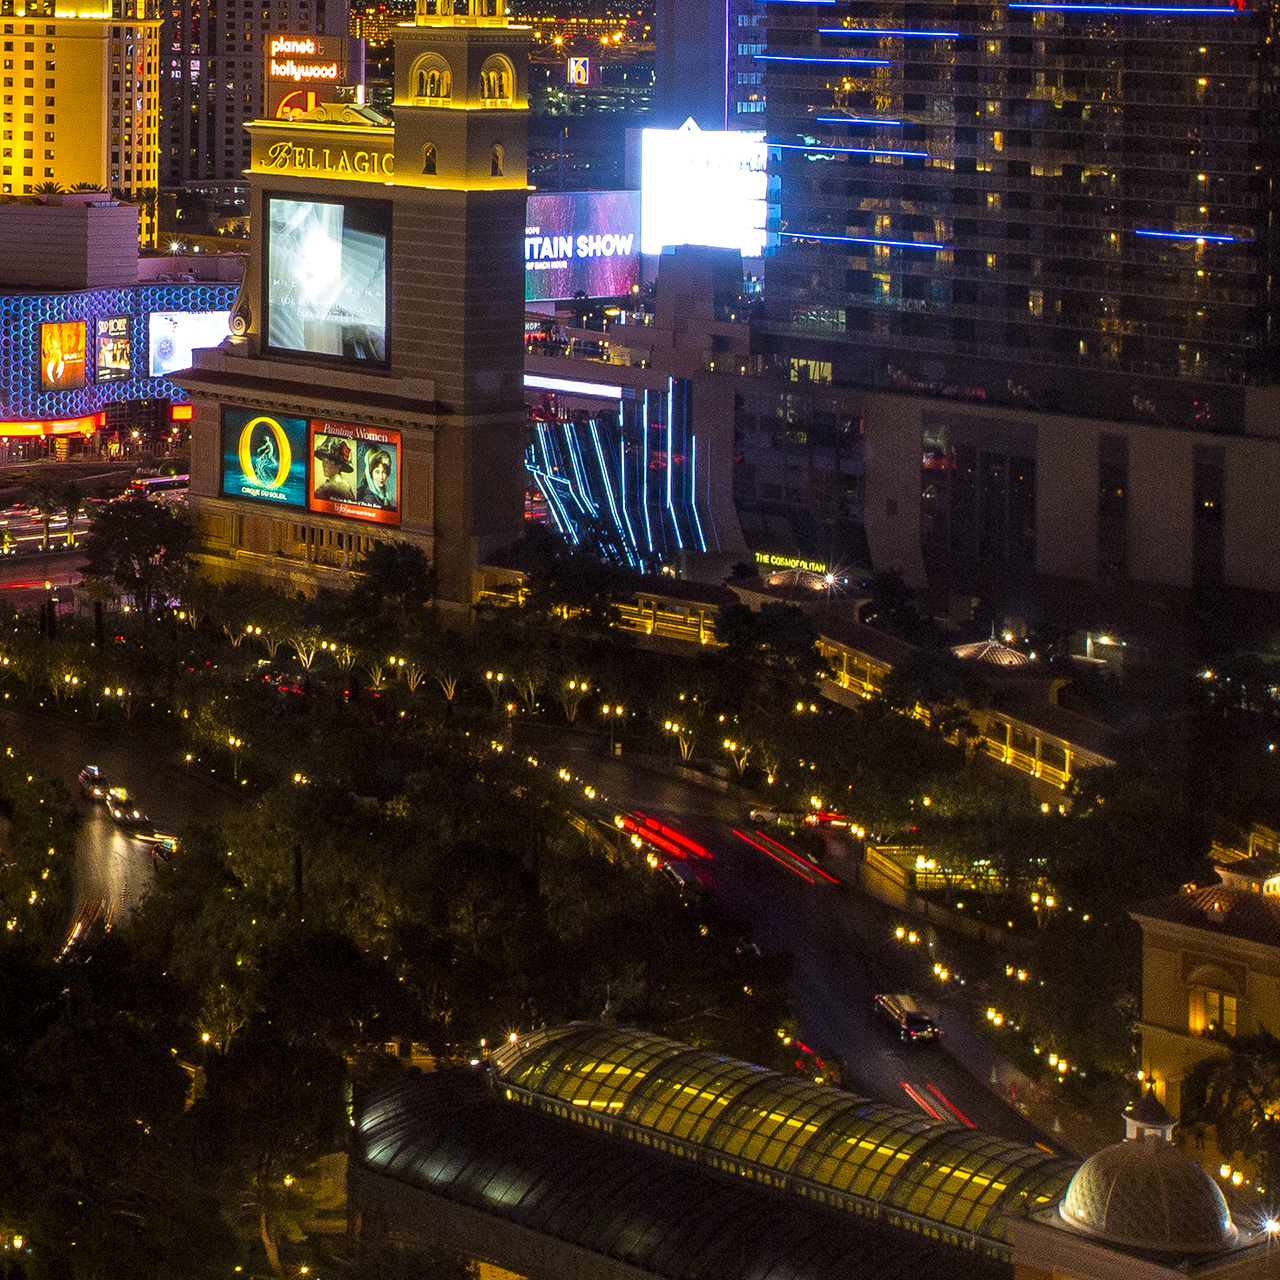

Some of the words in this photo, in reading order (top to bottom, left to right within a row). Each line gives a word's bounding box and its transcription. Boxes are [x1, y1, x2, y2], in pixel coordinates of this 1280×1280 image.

[271, 35, 316, 57] planet
[271, 59, 338, 82] hollywood
[575, 59, 586, 84] 6
[576, 233, 634, 258] SHOW
[280, 296, 296, 306] FOR
[323, 423, 354, 440] Painting
[355, 428, 389, 443] Women
[241, 486, 261, 497] CIRQUE
[261, 490, 270, 498] DU
[269, 491, 288, 501] SOLEIL
[755, 552, 770, 564] THE
[770, 555, 826, 573] COSMOPOLITAN
